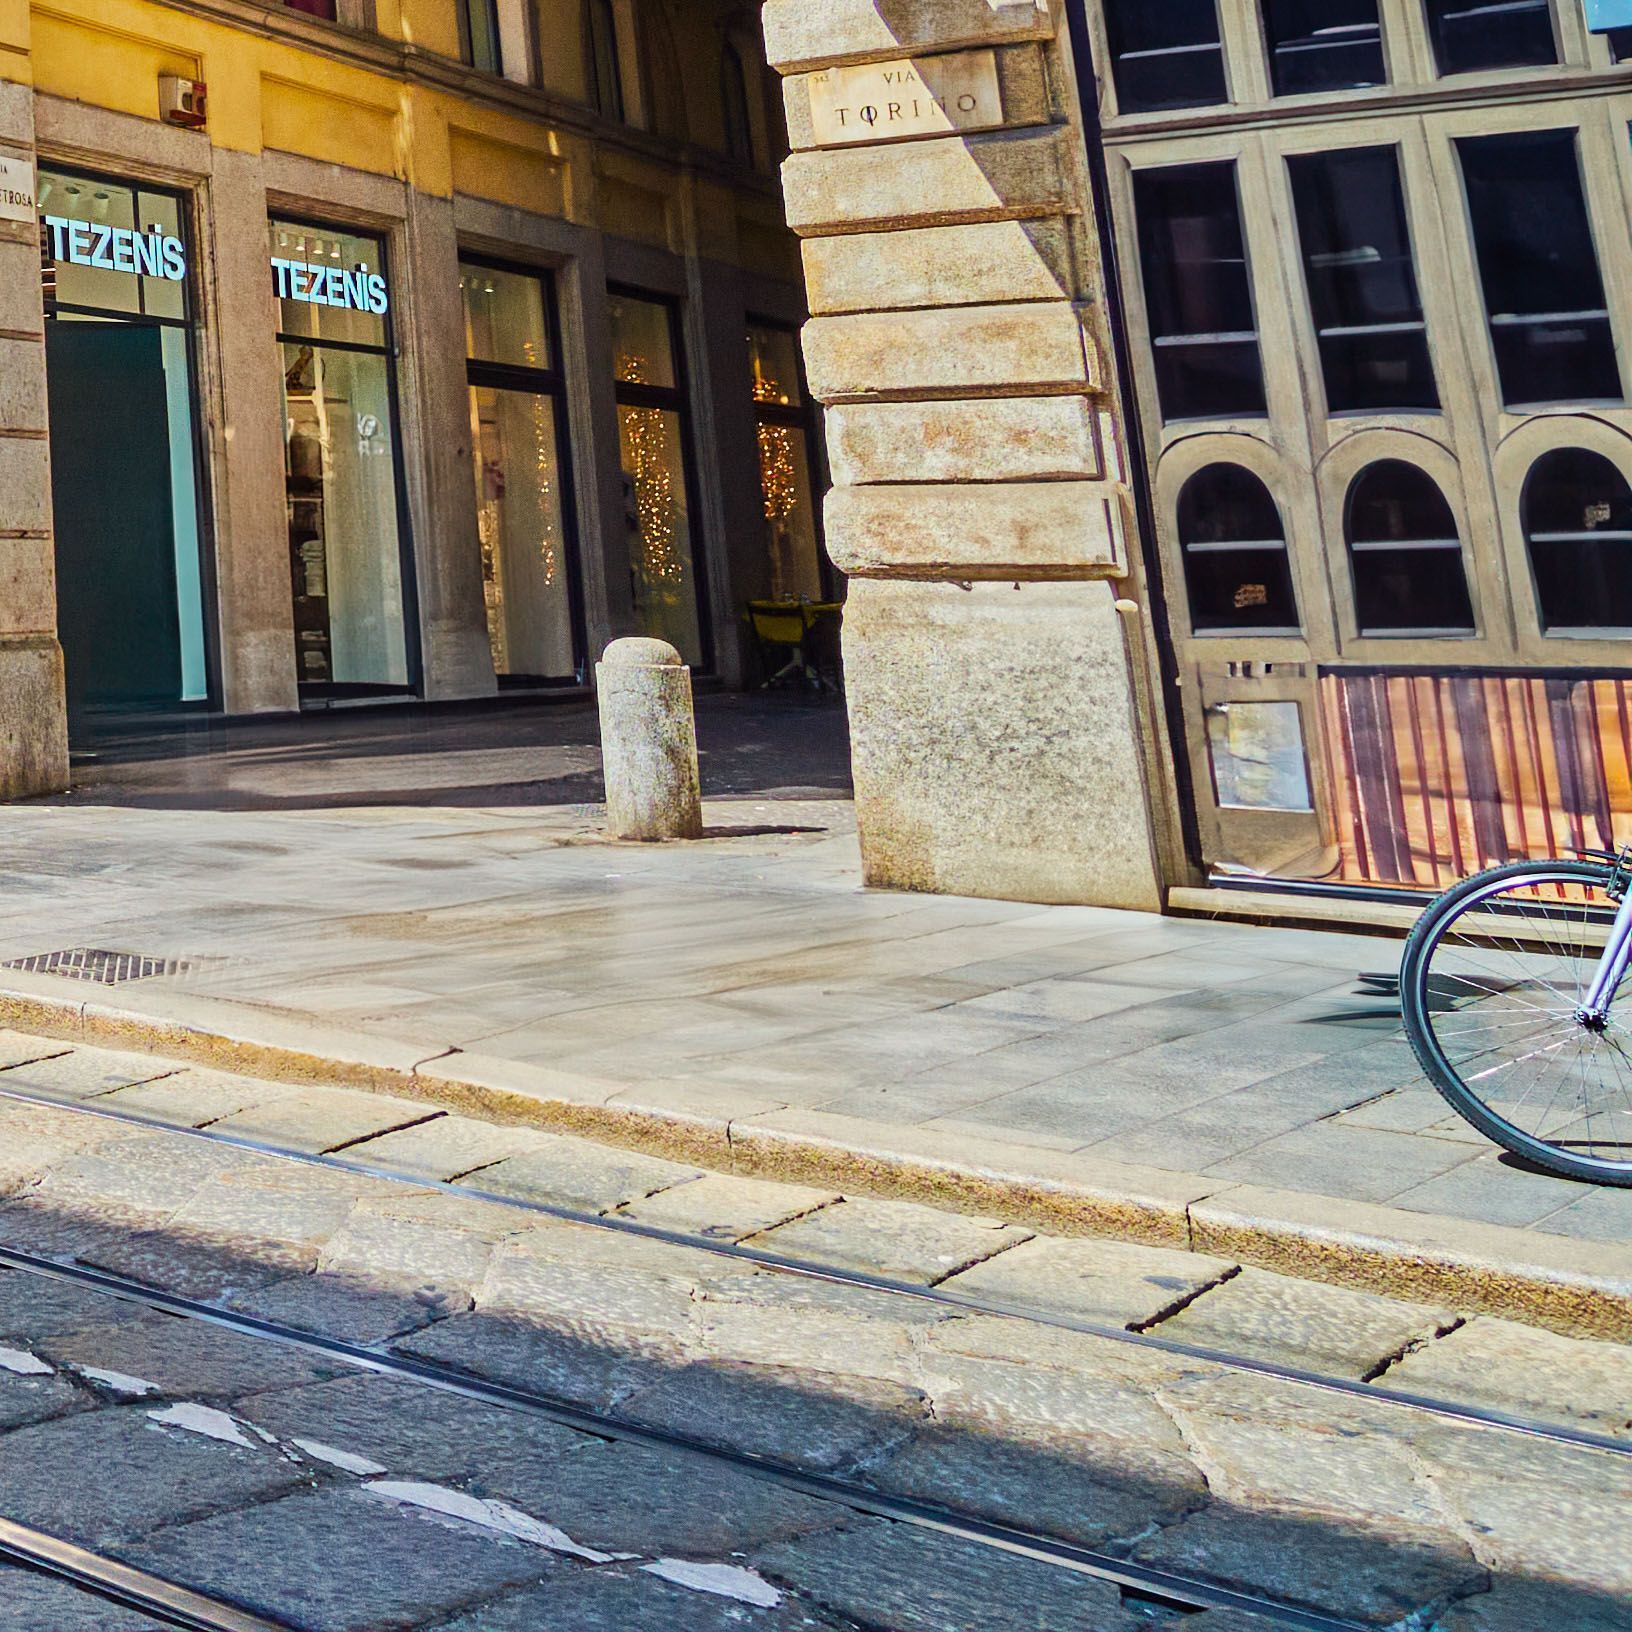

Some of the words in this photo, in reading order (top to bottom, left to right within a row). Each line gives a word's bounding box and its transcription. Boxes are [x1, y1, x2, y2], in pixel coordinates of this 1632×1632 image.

[883, 70, 915, 85] VIA
[834, 94, 977, 126] TORINO
[45, 215, 186, 281] TEZENIS
[271, 257, 388, 315] TEZENIS
